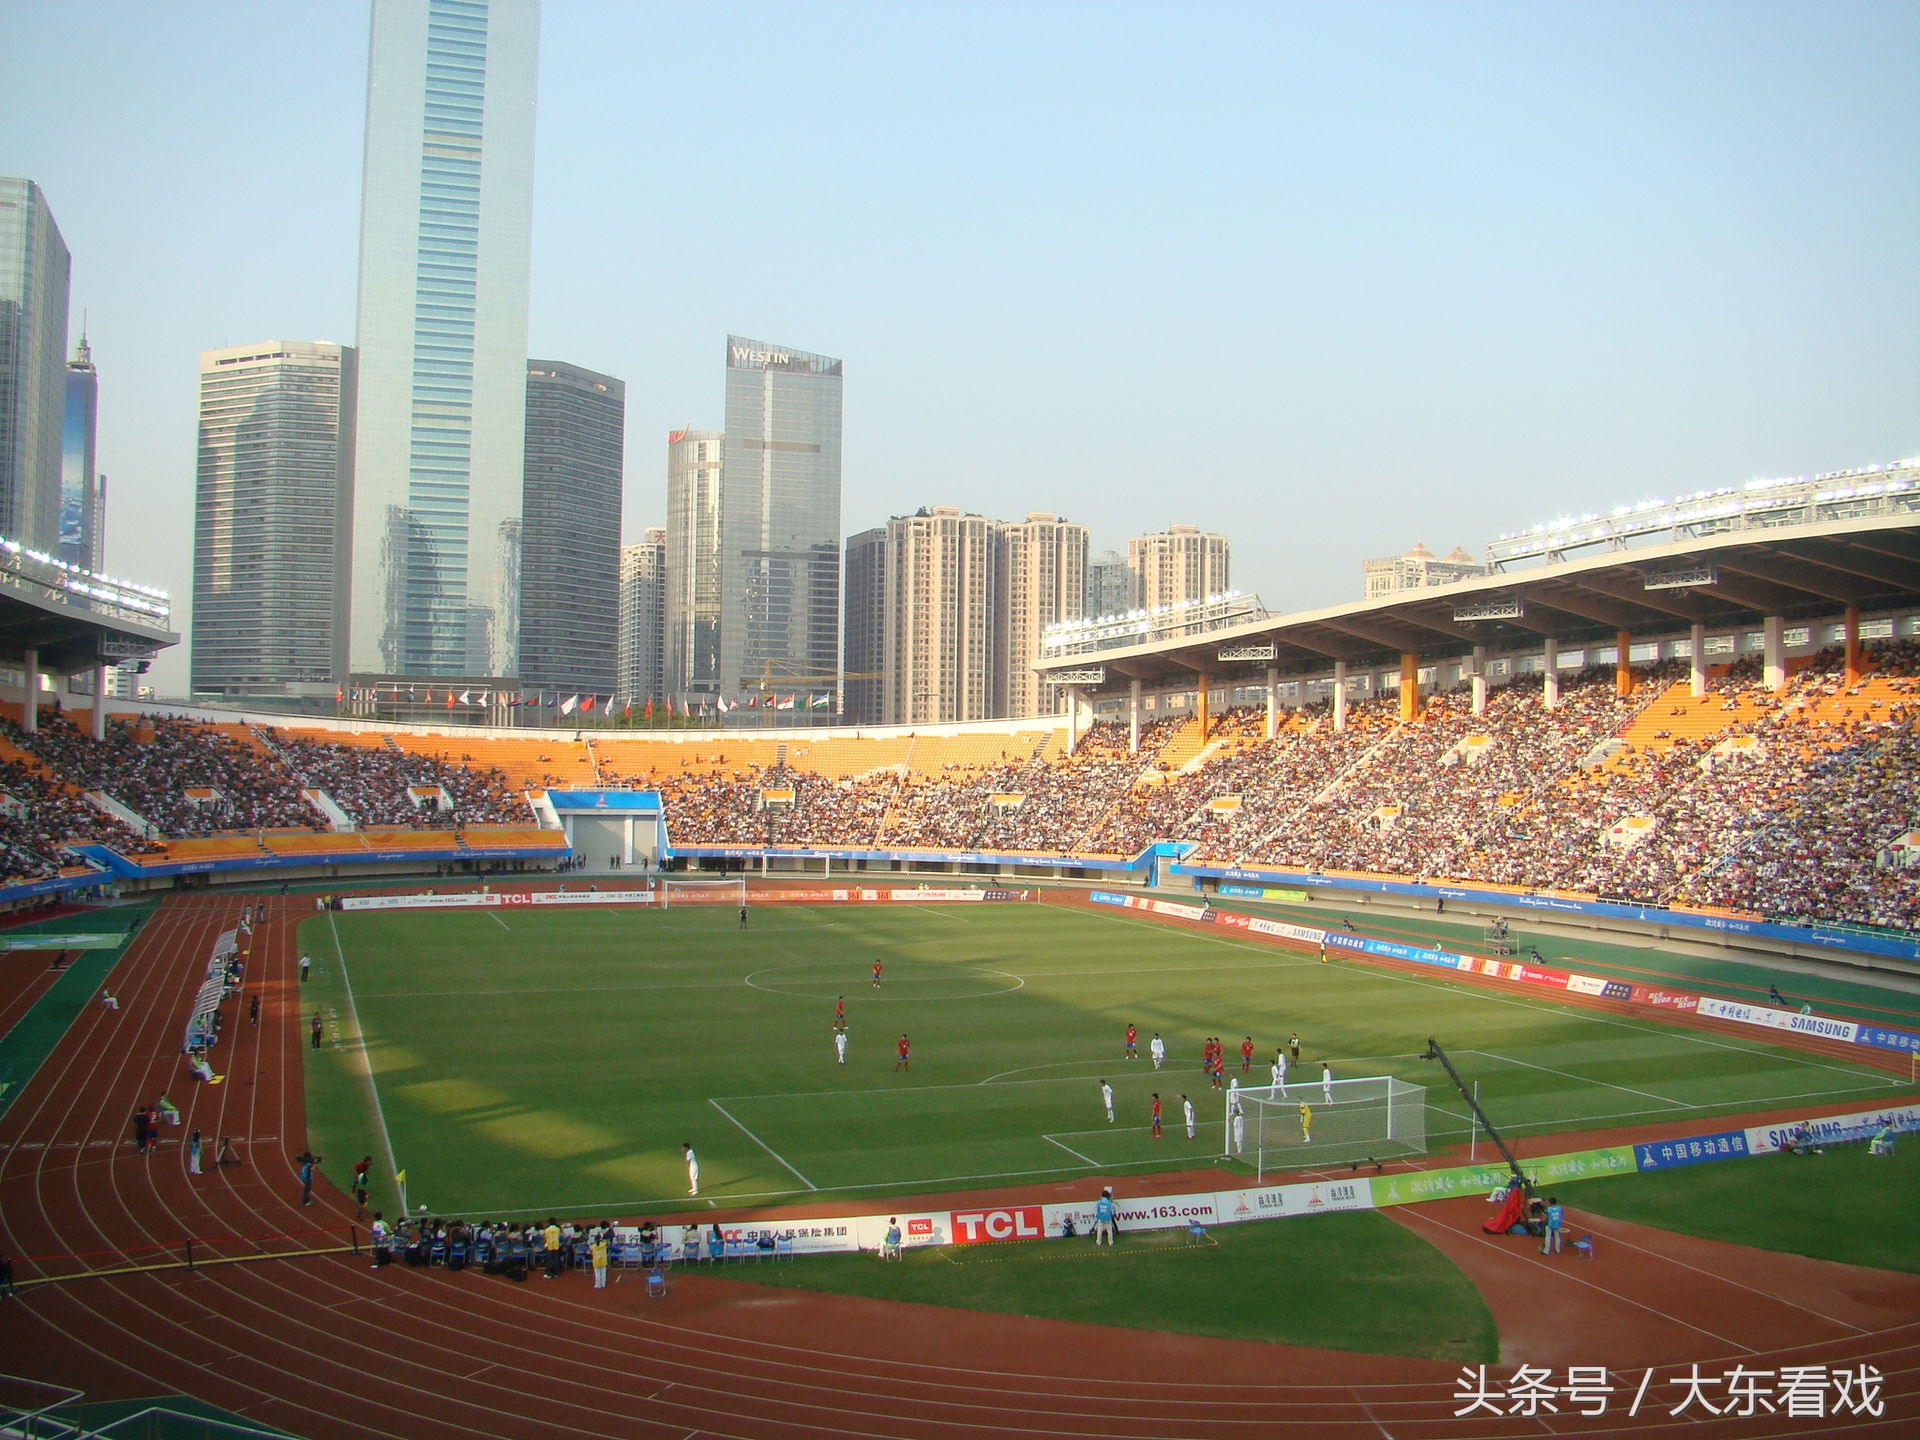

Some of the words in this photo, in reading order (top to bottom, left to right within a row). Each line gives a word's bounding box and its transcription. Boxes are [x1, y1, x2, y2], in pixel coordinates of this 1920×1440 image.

[732, 346, 789, 364] WESTIN
[502, 894, 530, 904] TCL
[1292, 928, 1322, 941] SAMSUNG
[1790, 1016, 1850, 1038] SAMSUNG
[1768, 1121, 1841, 1148] SAMUNG
[1661, 1136, 1744, 1161] 中国移动通信
[911, 1223, 929, 1231] TCL
[956, 1211, 1038, 1240] TCL
